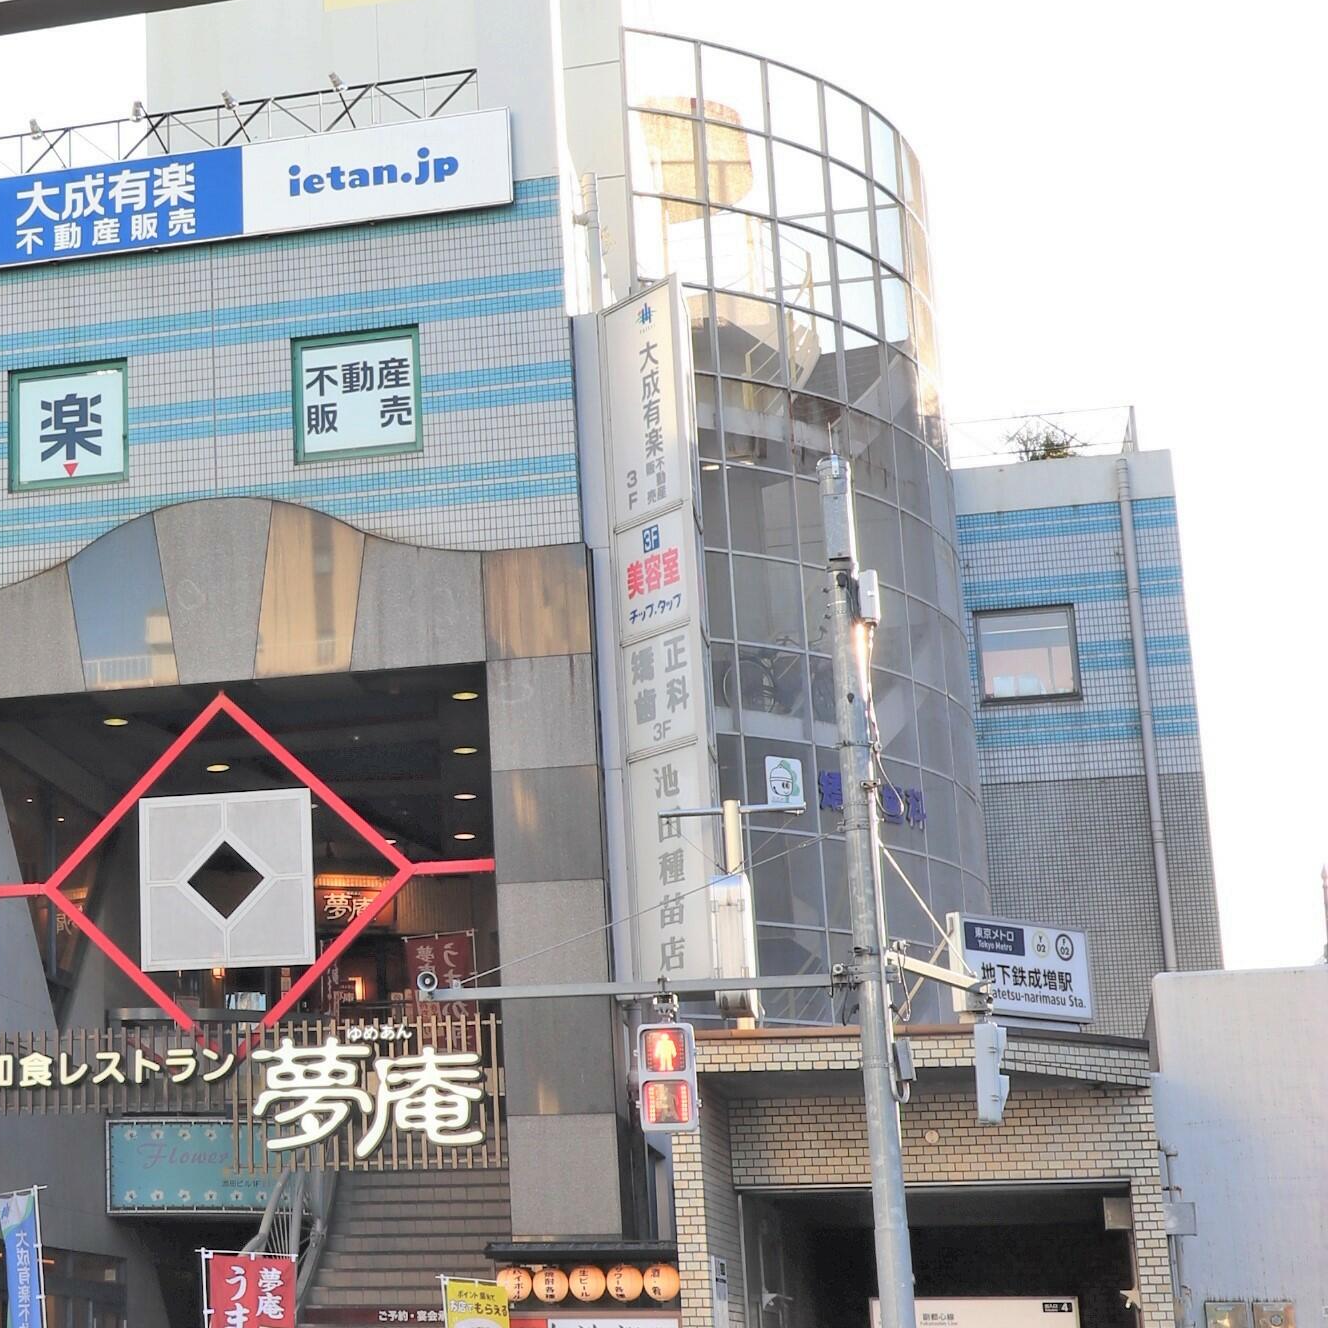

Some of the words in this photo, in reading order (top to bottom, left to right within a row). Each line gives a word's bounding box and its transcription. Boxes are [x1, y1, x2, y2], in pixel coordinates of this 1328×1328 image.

[287, 147, 460, 198] ietan.jp
[15, 161, 197, 224] 大成有楽
[15, 206, 197, 256] 不動産販売
[304, 356, 412, 399] 不動産
[639, 341, 664, 458] 大成有楽
[39, 392, 103, 463] 楽
[643, 526, 659, 551] 3F
[626, 546, 681, 601] 美容室
[653, 720, 672, 742] 3F
[653, 763, 686, 973] 池田種苗店
[974, 926, 1014, 942] 東京メトロ
[978, 939, 995, 951] Tokyo
[995, 941, 1013, 952] Metro
[1036, 943, 1046, 953] 02
[1059, 946, 1070, 956] 02
[981, 961, 1074, 992] 地下鉄成増駅
[991, 988, 1066, 1006] atetsu-narimasu
[1068, 994, 1087, 1009] Sta.
[346, 1024, 413, 1041] ゆめあん
[250, 1035, 485, 1160] 夢庵
[137, 1141, 229, 1170] Flower
[255, 1267, 285, 1320] 夢庵
[512, 1269, 524, 1300] ハイボール
[578, 1269, 590, 1298] 生ビール
